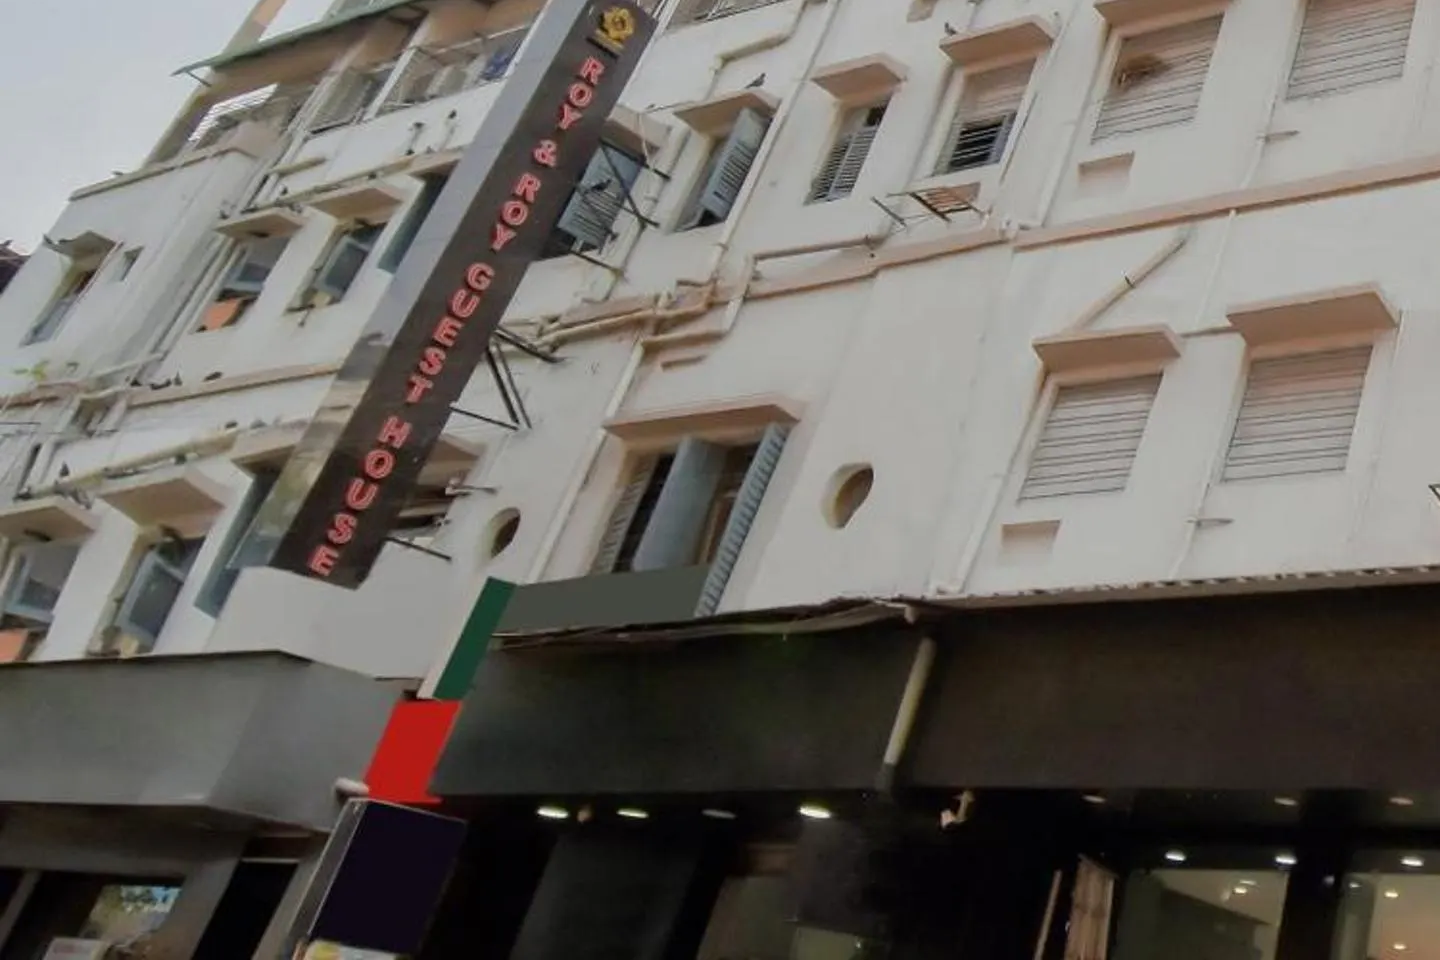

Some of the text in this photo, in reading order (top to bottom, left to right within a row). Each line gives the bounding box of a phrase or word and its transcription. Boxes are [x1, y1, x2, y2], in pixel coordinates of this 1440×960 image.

[308, 56, 604, 576] ROY & ROY GUEST HOUSE
